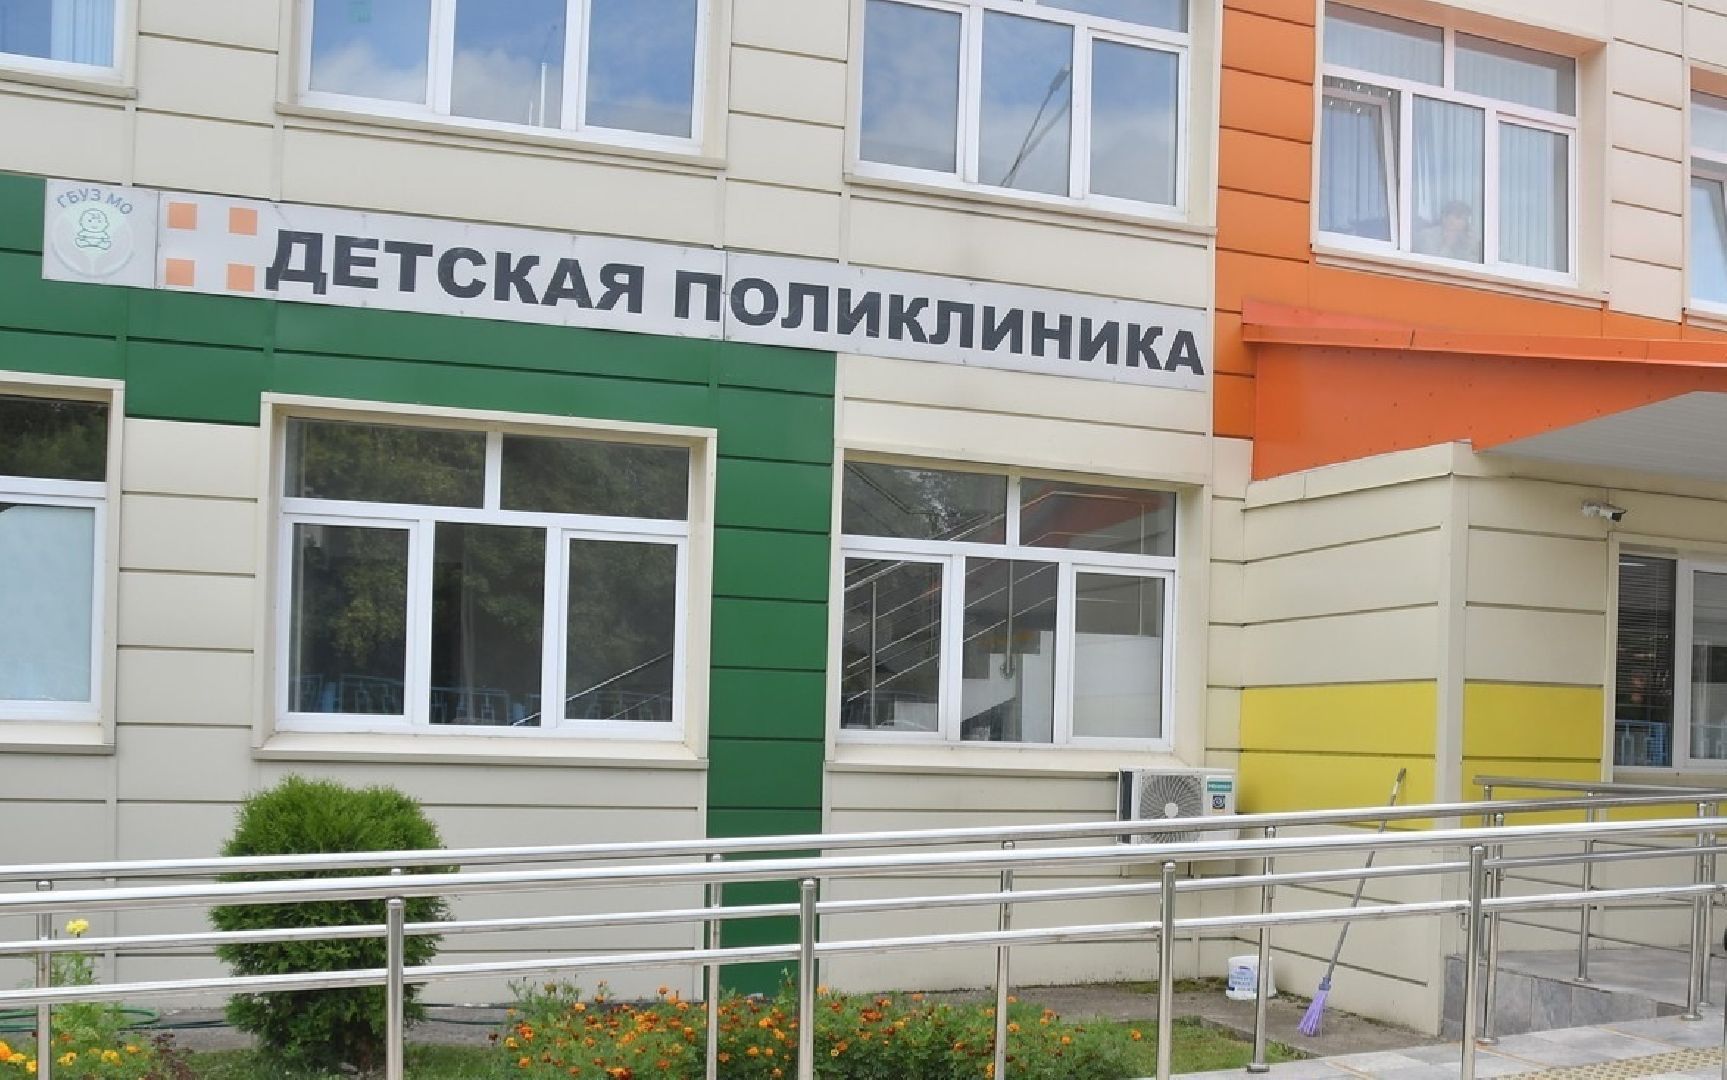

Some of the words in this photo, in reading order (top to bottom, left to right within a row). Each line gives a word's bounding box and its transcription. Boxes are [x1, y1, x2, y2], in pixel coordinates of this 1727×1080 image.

[57, 188, 101, 208] ГБУЗ
[106, 192, 133, 215] МО
[265, 228, 645, 314] ДЕТСКАЯ
[674, 269, 1205, 376] ПОЛИКЛИНИКА
